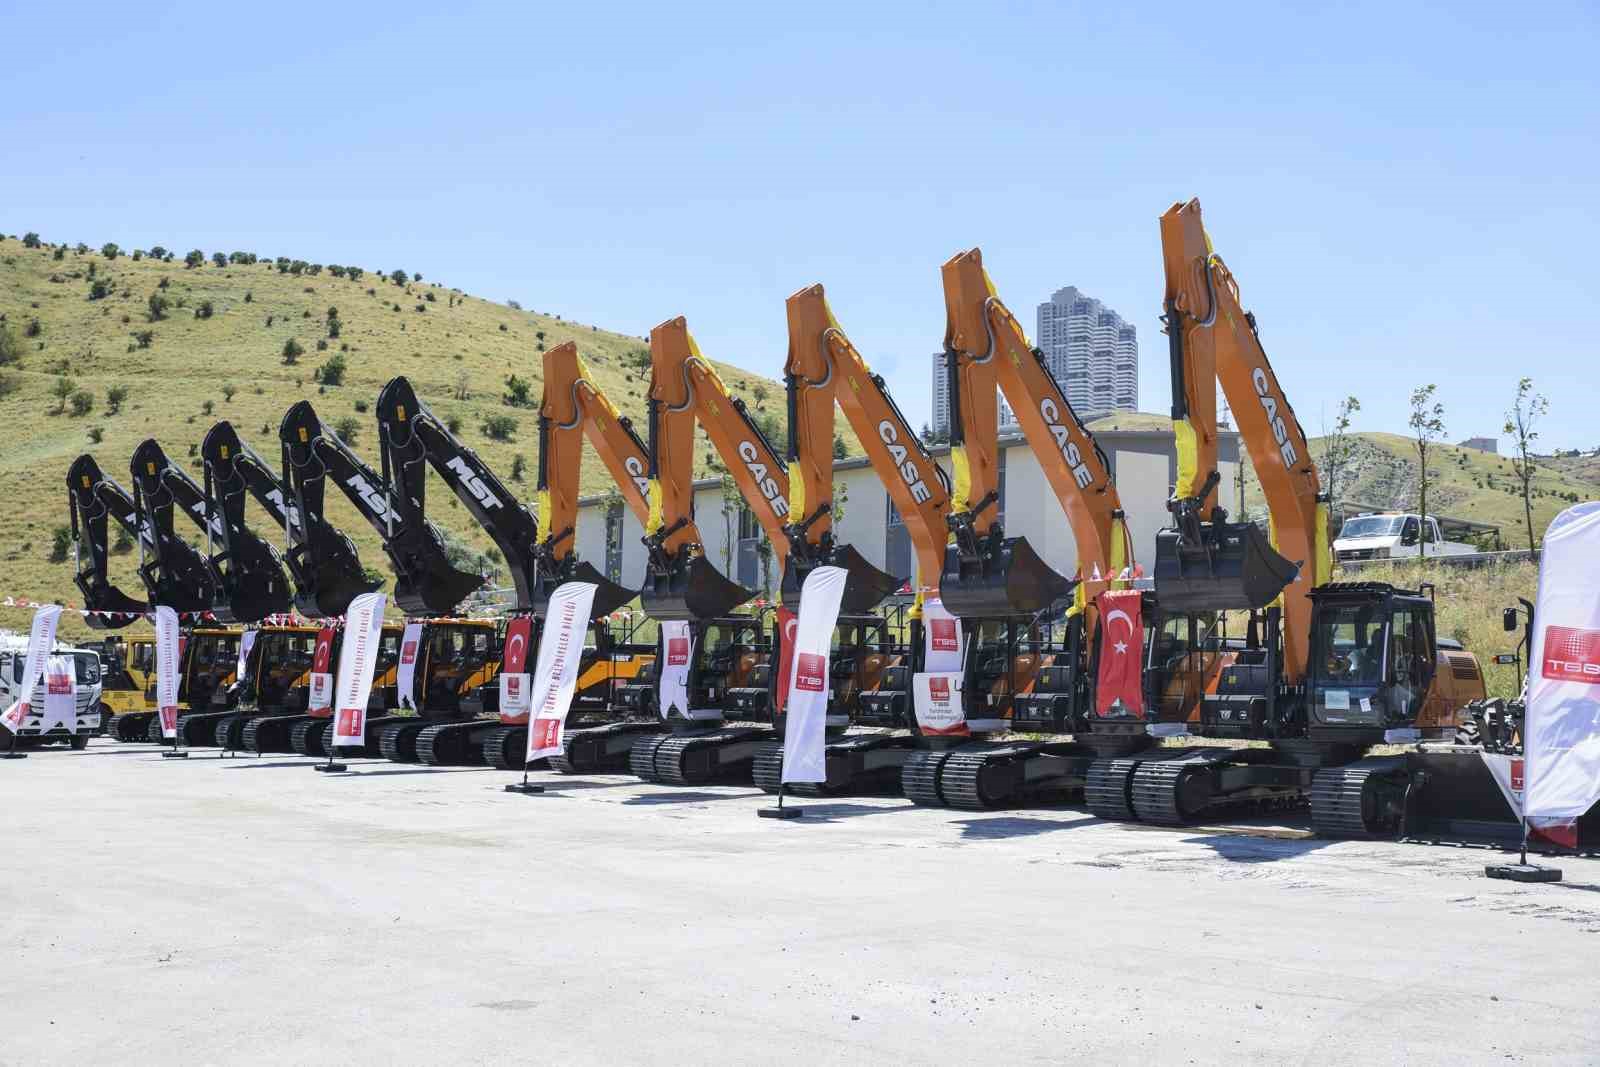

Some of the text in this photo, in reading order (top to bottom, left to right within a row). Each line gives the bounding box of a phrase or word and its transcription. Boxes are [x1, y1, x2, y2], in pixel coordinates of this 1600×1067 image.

[1251, 367, 1297, 469] CASE
[878, 420, 932, 504] CASE
[1040, 398, 1094, 489] CASE
[346, 474, 402, 522] MST
[446, 456, 504, 508] MST
[625, 456, 649, 497] CA
[738, 441, 789, 518] CASE
[265, 489, 301, 532] MS
[797, 675, 822, 686] TBB
[1547, 659, 1600, 674] TBB
